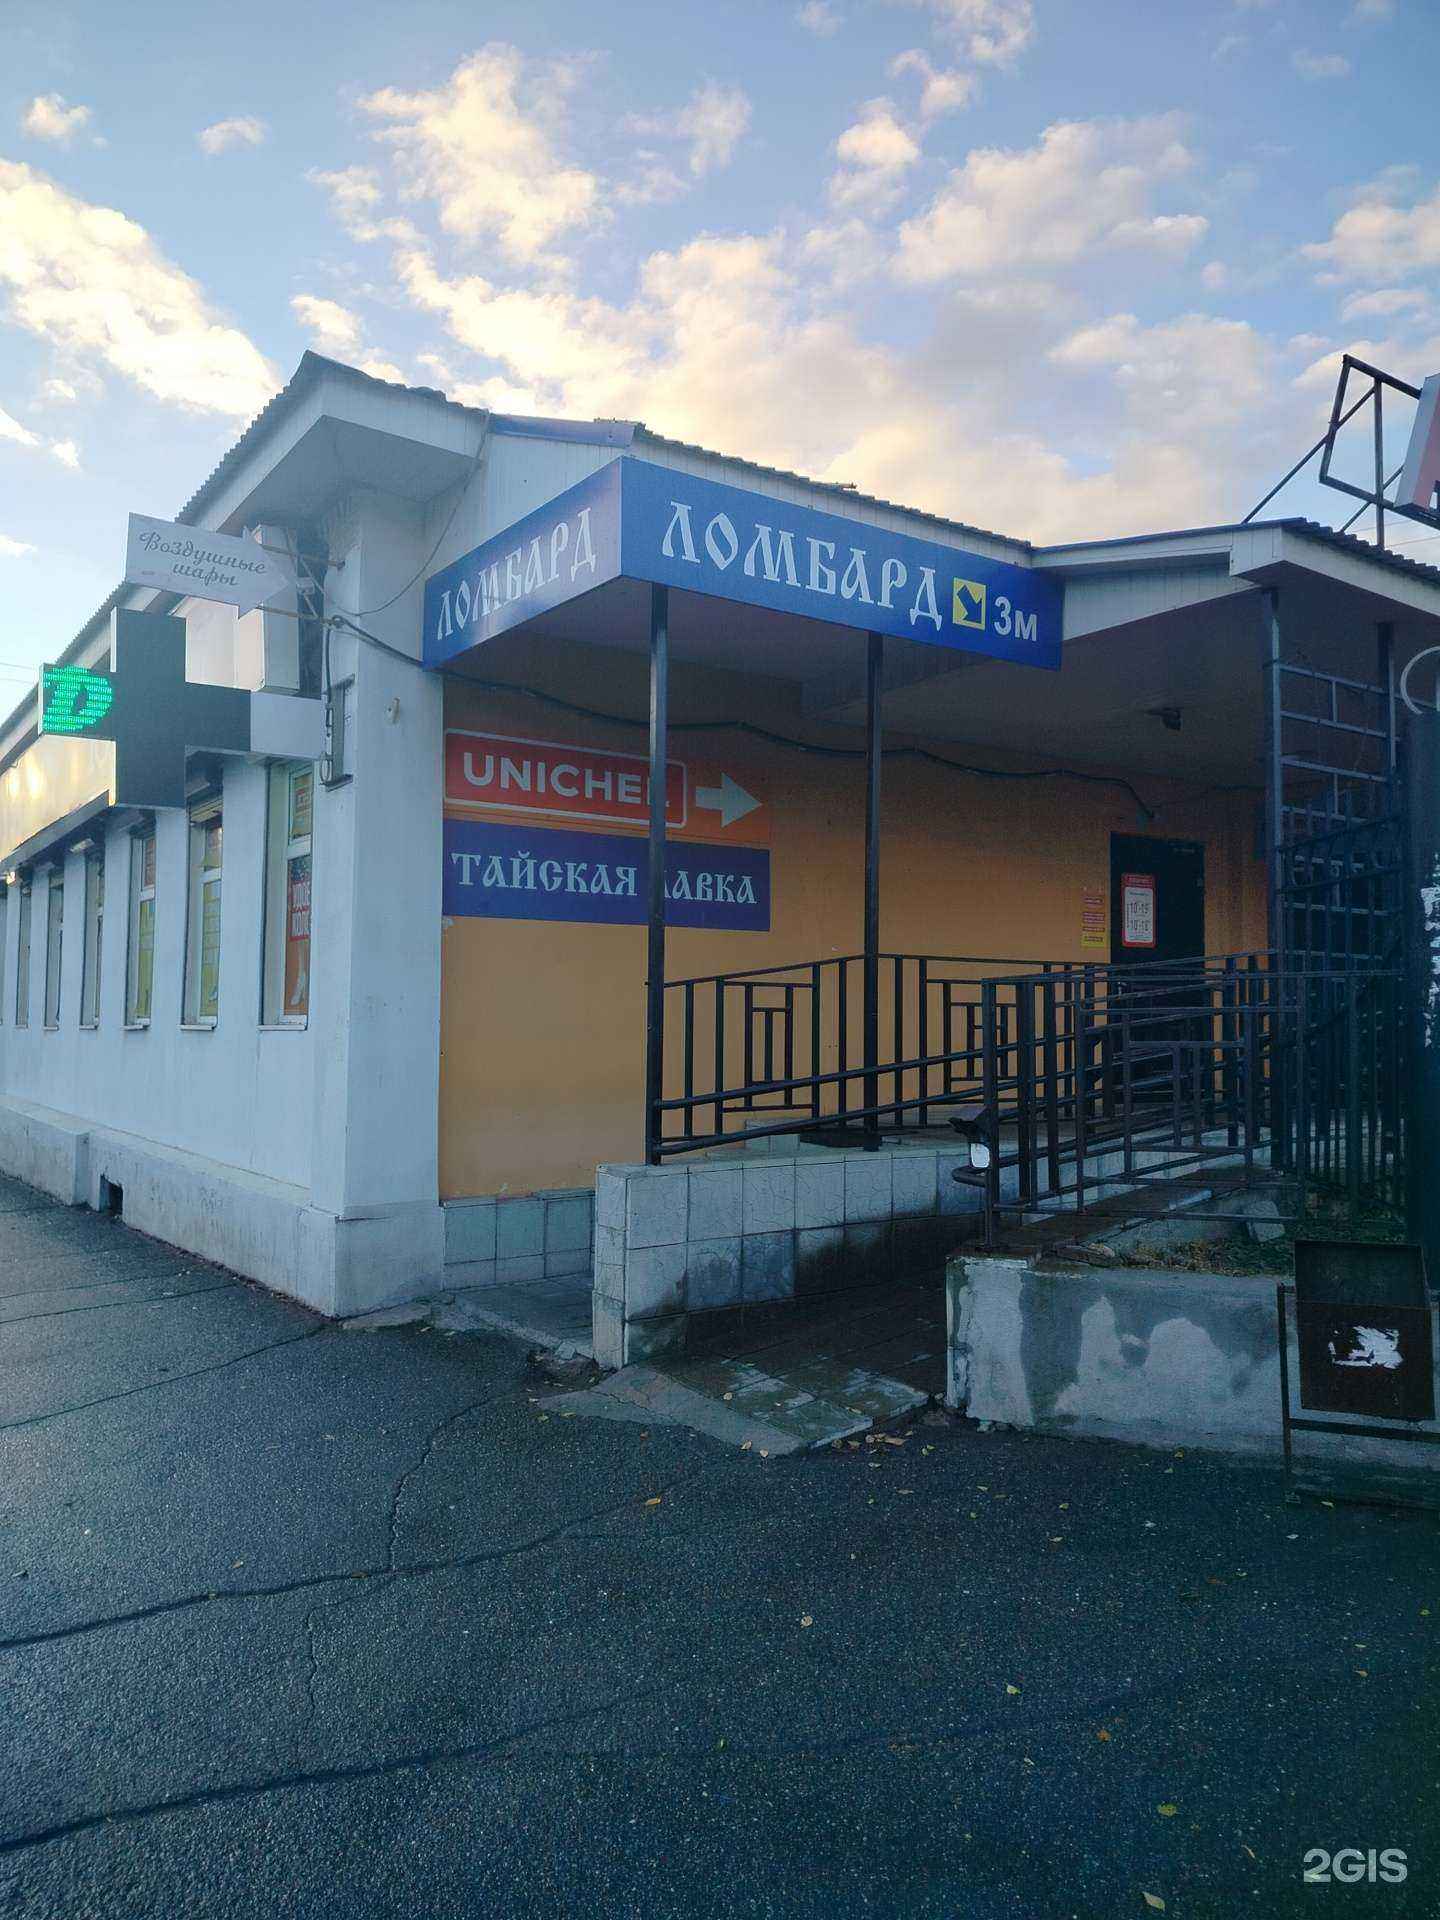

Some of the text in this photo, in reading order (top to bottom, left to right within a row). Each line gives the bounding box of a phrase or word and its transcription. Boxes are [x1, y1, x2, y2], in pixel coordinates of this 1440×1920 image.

[139, 531, 267, 574] Воздушные
[172, 563, 239, 586] шары
[437, 507, 597, 641] ЛОМБАРД
[661, 500, 943, 632] ЛОМБАРД
[450, 850, 638, 896] ТАЙСКАЯ
